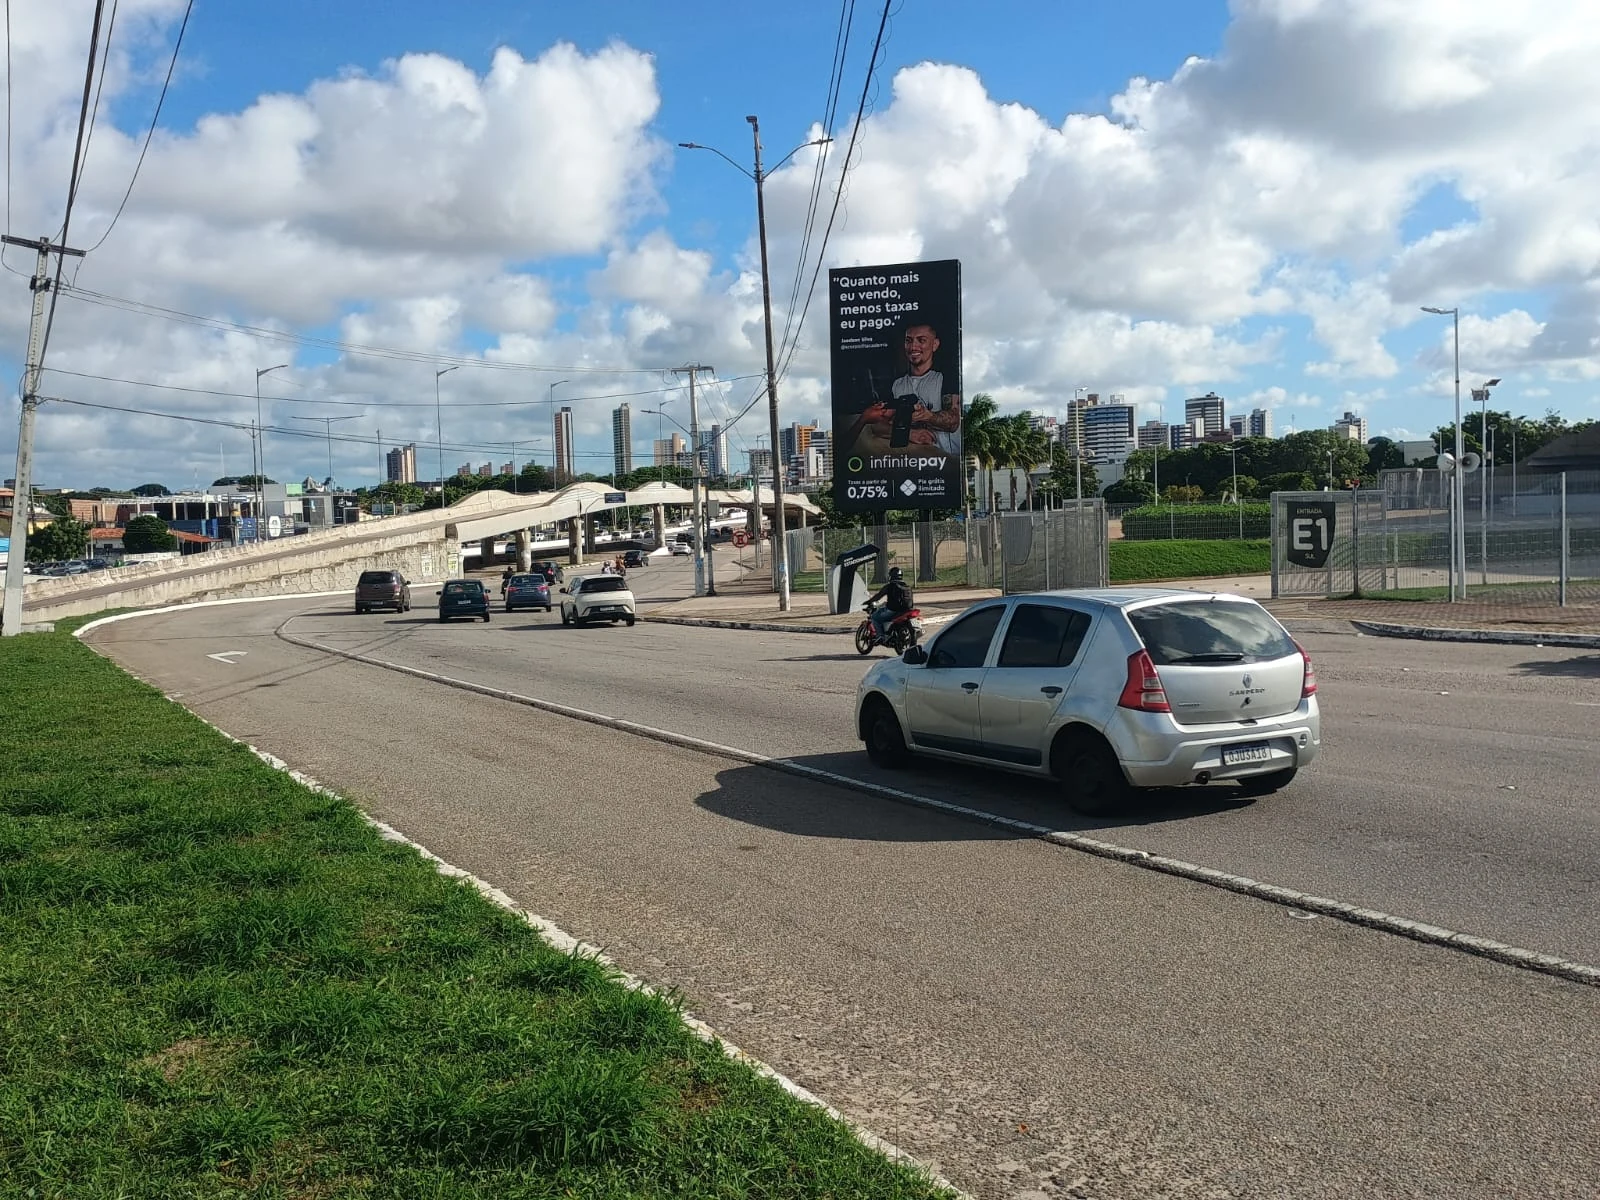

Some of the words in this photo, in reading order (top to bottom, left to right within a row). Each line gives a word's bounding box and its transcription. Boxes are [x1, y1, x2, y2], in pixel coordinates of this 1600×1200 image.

[890, 271, 920, 284] mais
[840, 292, 855, 302] eu
[858, 287, 901, 300] vendo,
[840, 304, 882, 315] menos
[885, 301, 919, 312] taxas
[840, 320, 855, 329] eu
[870, 454, 947, 471] infinitepay
[1293, 517, 1328, 551] E1
[1229, 687, 1266, 697] SANDERO
